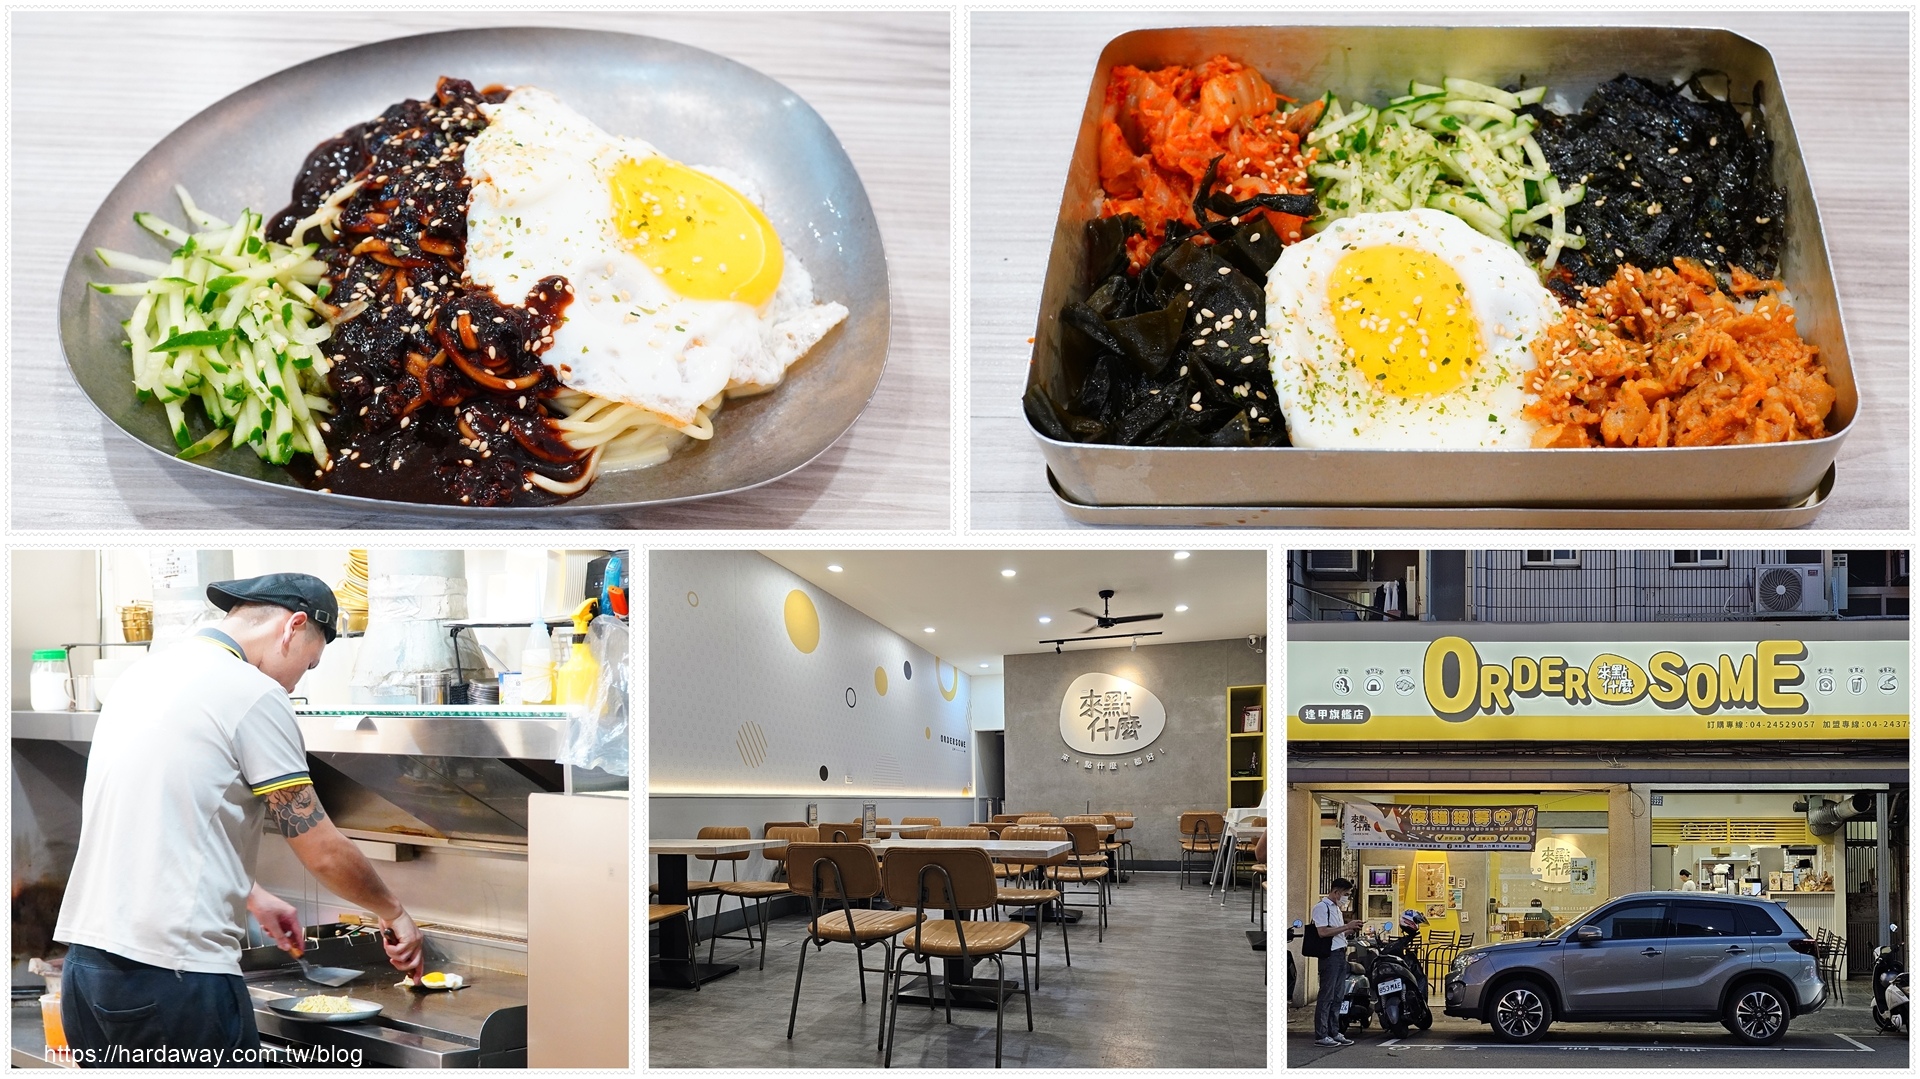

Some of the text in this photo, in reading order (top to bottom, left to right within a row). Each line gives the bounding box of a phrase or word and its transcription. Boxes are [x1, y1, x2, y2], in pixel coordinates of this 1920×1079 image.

[1423, 635, 1809, 722] ORDER SOME
[1597, 662, 1628, 680] 來點
[1602, 680, 1634, 694] 什麼
[1079, 689, 1132, 718] 來點
[1304, 709, 1364, 720] 逢甲旗艦店
[1087, 716, 1142, 742] 什麼
